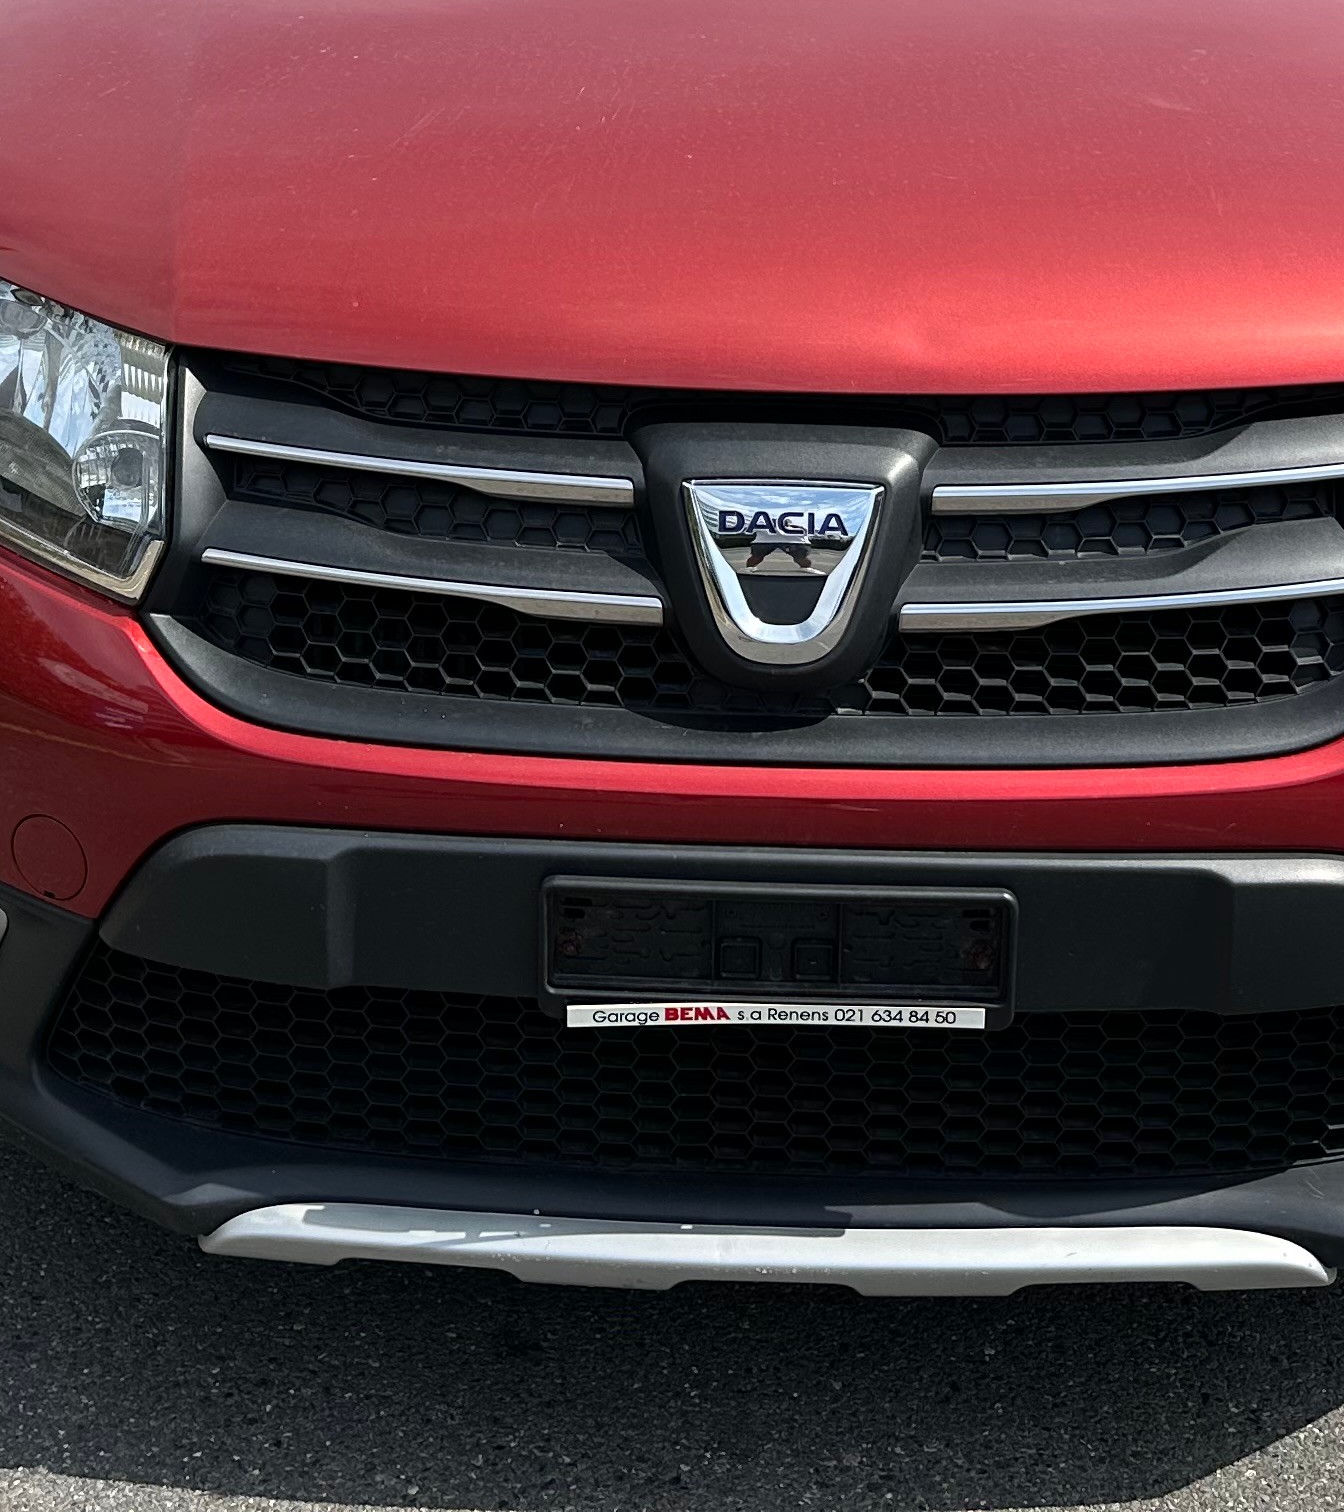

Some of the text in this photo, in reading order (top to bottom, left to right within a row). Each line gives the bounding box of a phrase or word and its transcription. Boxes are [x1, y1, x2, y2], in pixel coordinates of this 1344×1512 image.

[717, 510, 849, 537] DACIA
[592, 1009, 660, 1025] Garage
[664, 1007, 731, 1021] BEMA
[767, 1008, 829, 1021] Renens
[835, 1009, 864, 1022] 021
[871, 1009, 904, 1023] 634
[908, 1011, 929, 1024] 84
[935, 1011, 957, 1024] 50
